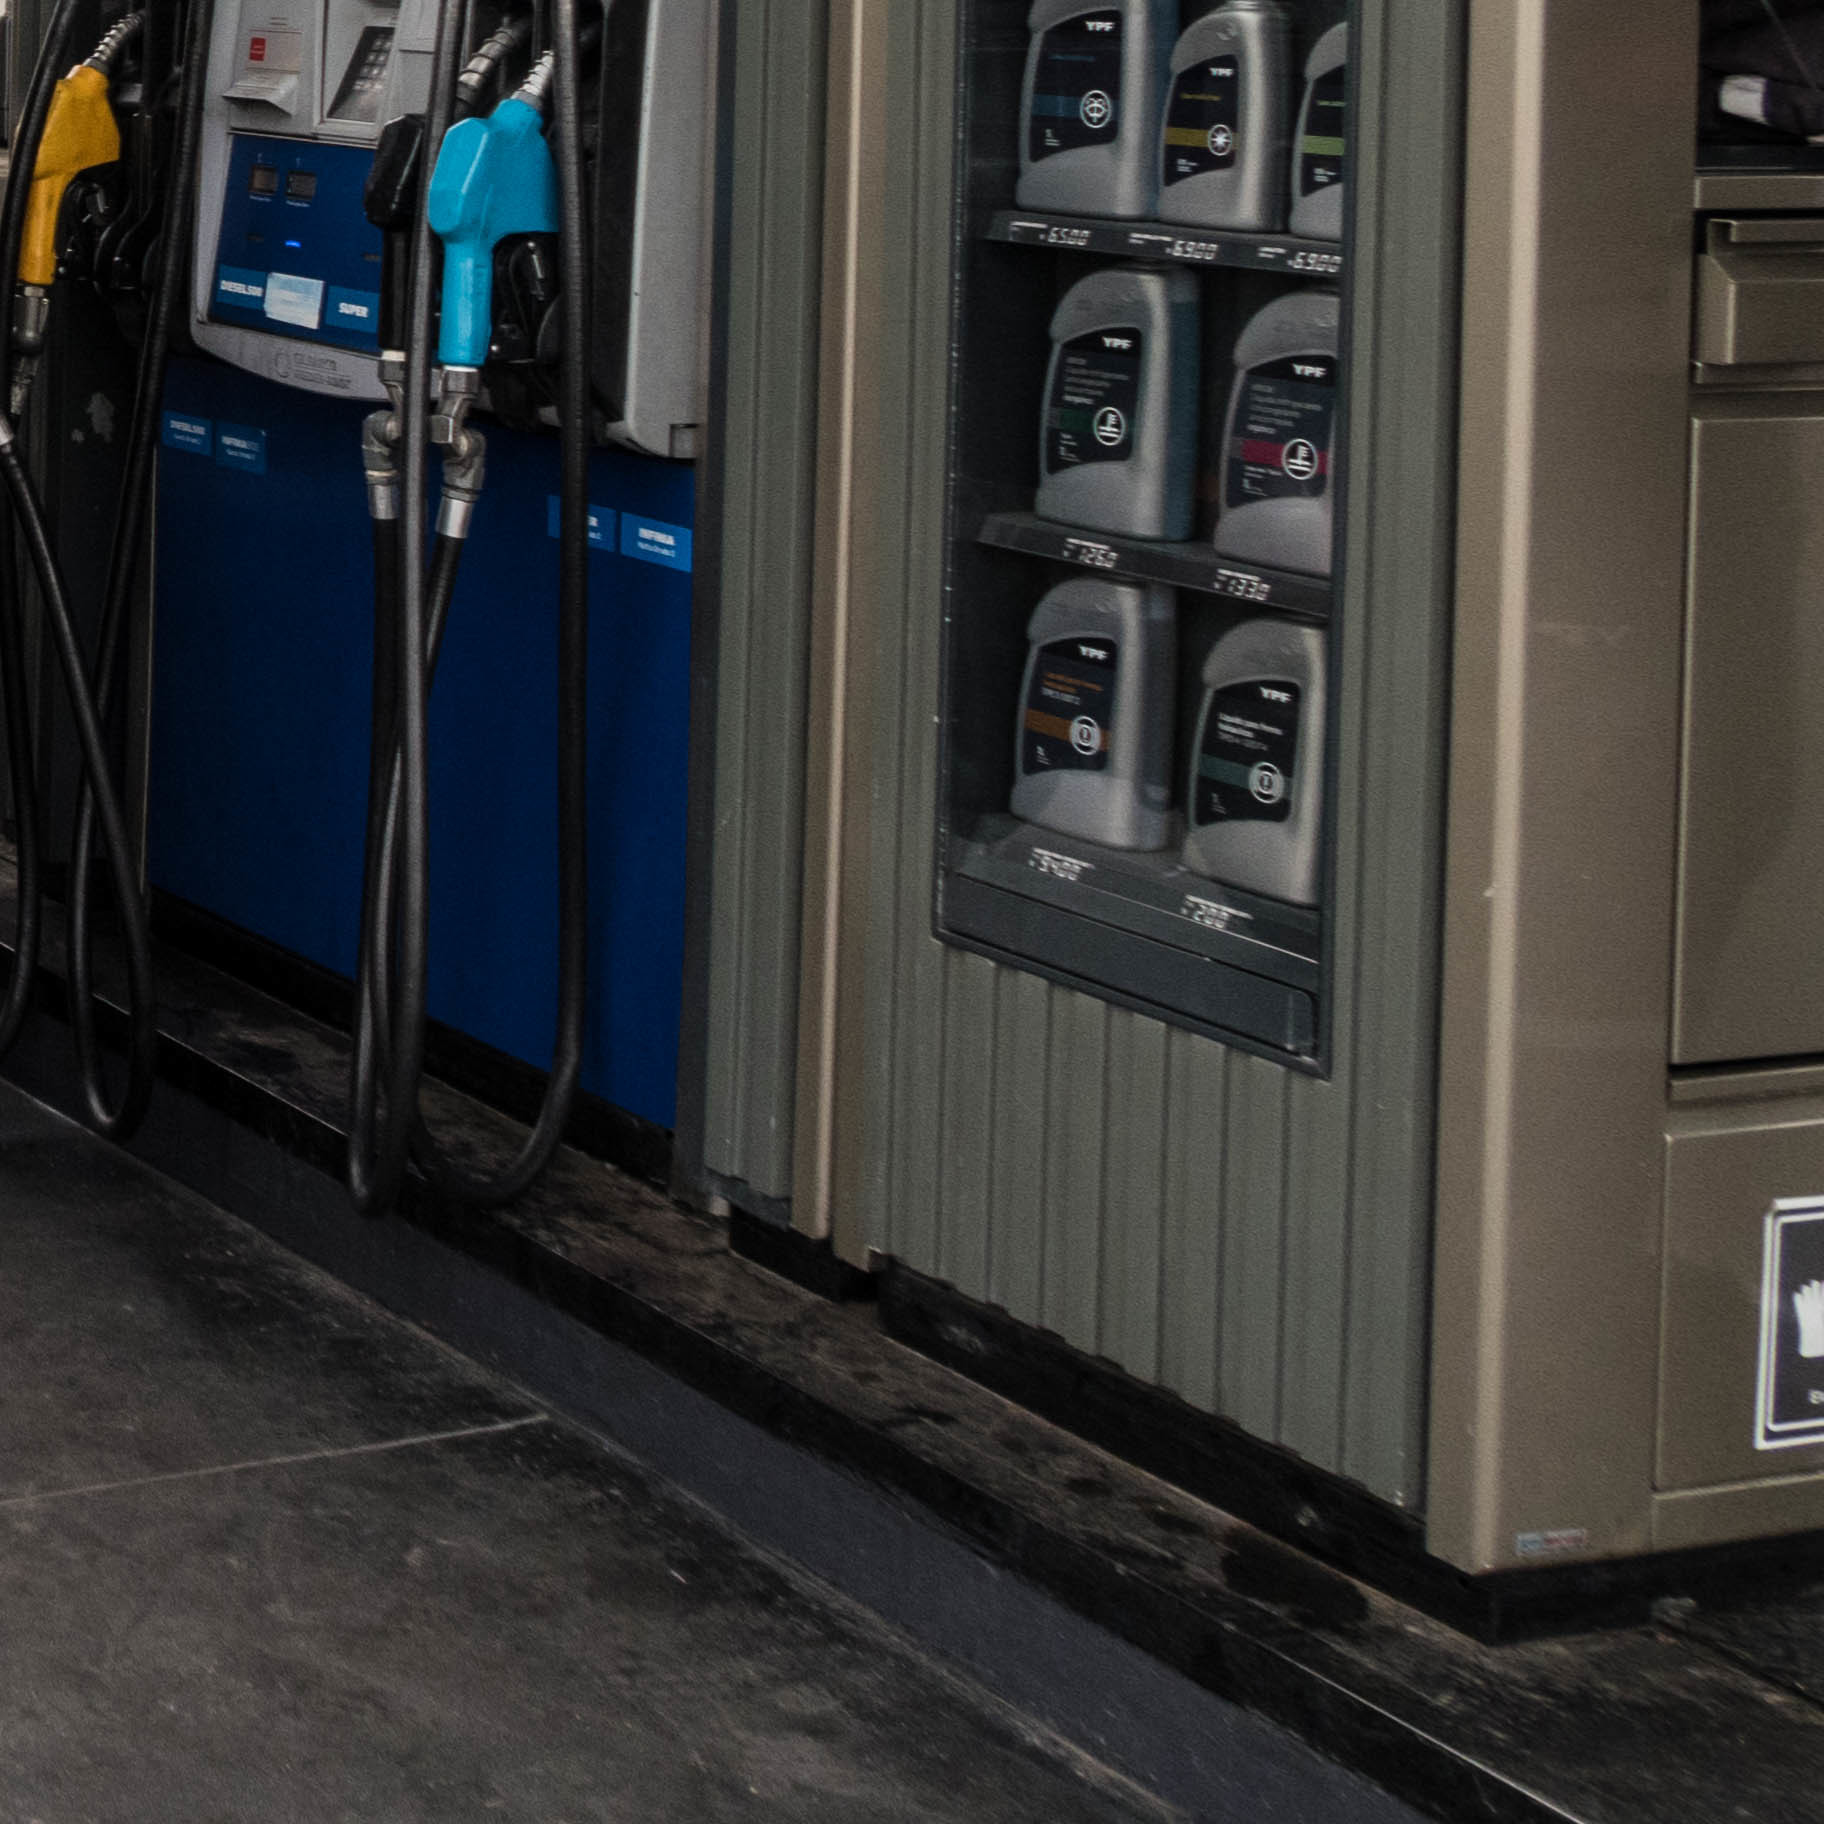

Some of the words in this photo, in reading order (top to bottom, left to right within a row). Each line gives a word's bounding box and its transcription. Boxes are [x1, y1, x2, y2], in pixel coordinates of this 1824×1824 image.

[1085, 20, 1114, 32] YPF
[1210, 67, 1234, 76] YPF
[338, 302, 369, 318] SUPER
[1103, 336, 1133, 349] YPF
[1292, 363, 1327, 378] YPF
[1079, 644, 1109, 660] YPF
[1259, 686, 1293, 703] YPF
